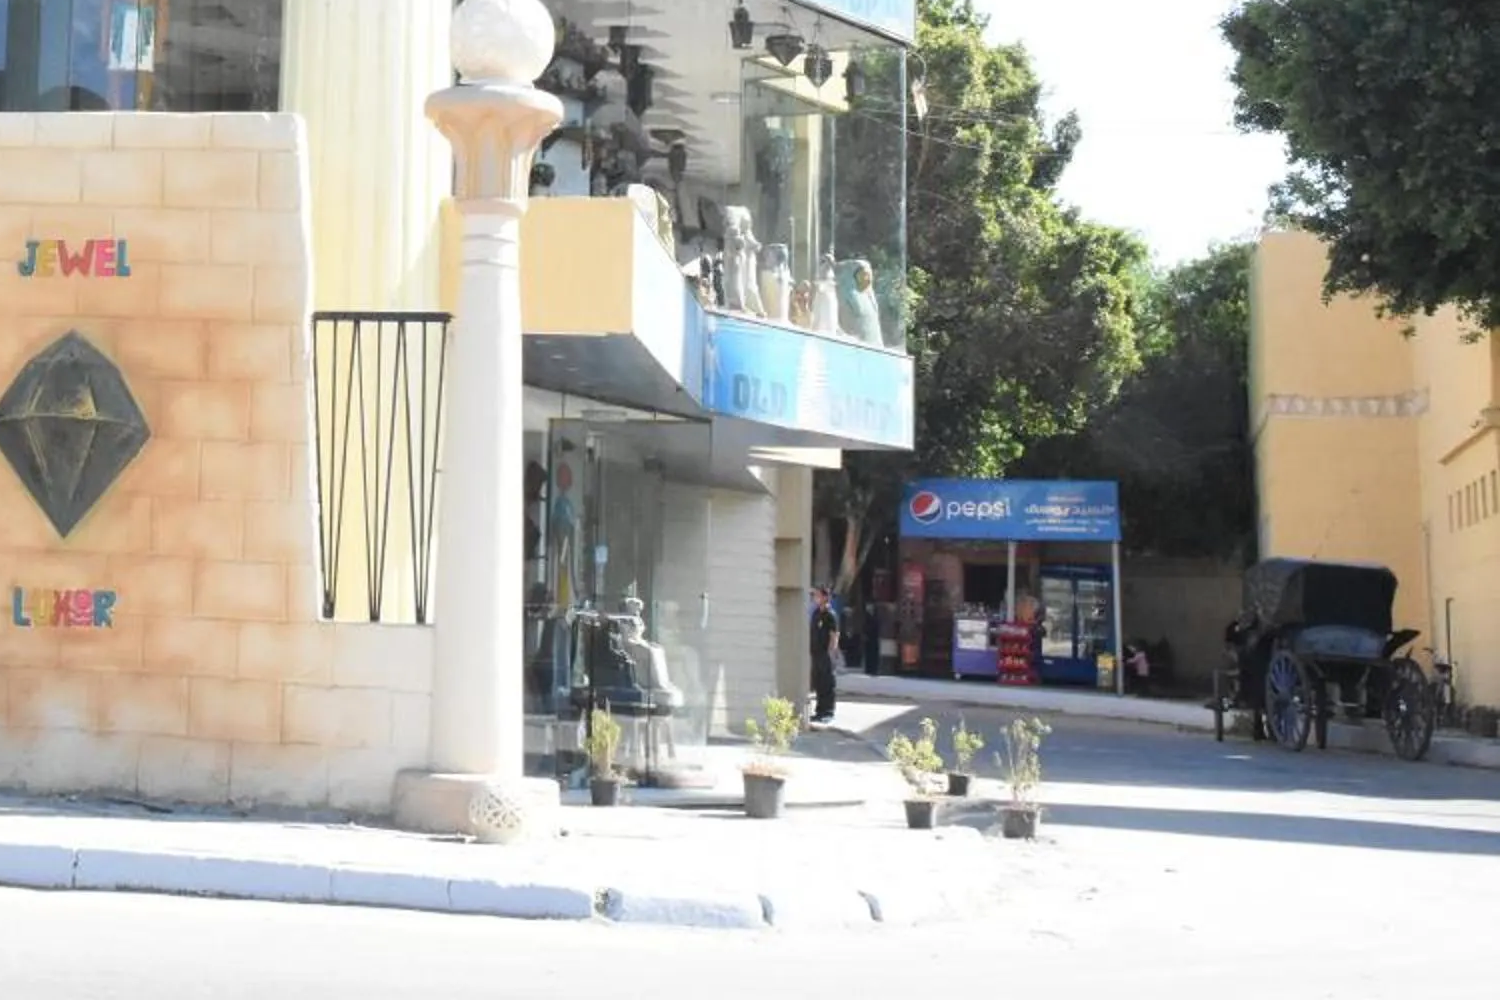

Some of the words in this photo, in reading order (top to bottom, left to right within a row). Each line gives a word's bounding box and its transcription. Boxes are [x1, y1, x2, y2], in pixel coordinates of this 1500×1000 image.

[17, 239, 131, 278] JEWEL
[732, 373, 788, 417] OLD
[946, 497, 1011, 521] pepsi
